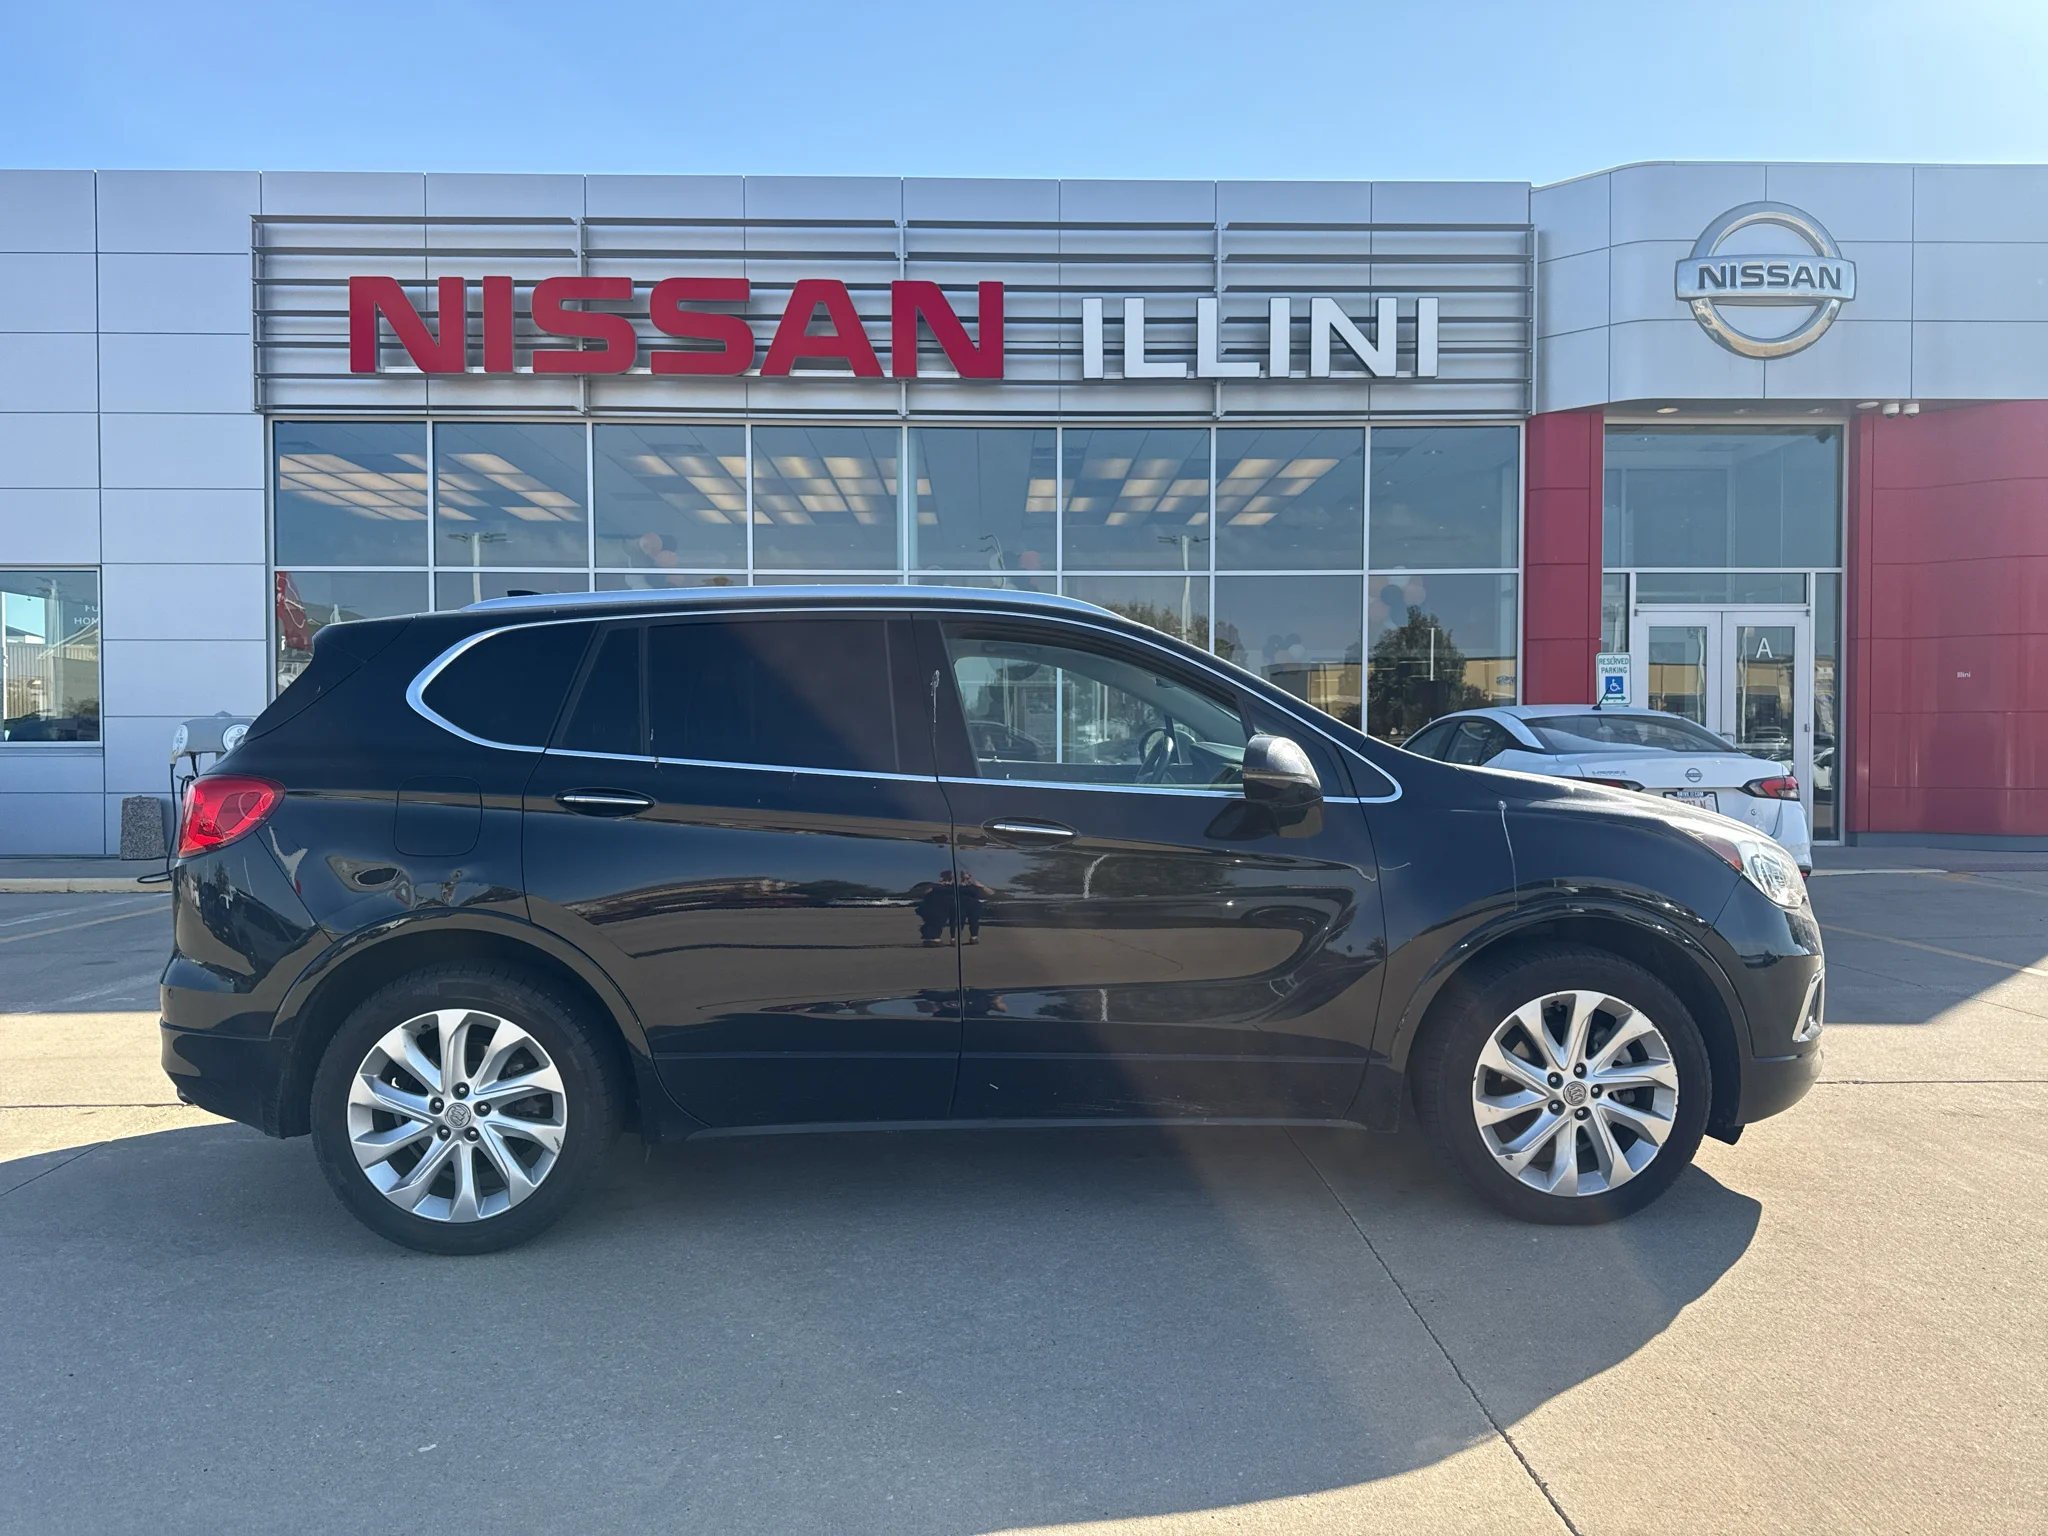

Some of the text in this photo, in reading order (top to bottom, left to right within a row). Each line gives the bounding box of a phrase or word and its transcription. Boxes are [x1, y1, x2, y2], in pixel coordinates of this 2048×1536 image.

[1698, 264, 1841, 290] NISSAN
[348, 275, 1440, 380] NISSAN ILLINI
[1755, 637, 1773, 659] A
[1599, 657, 1629, 665] RESERVED
[1601, 666, 1628, 674] PARKING
